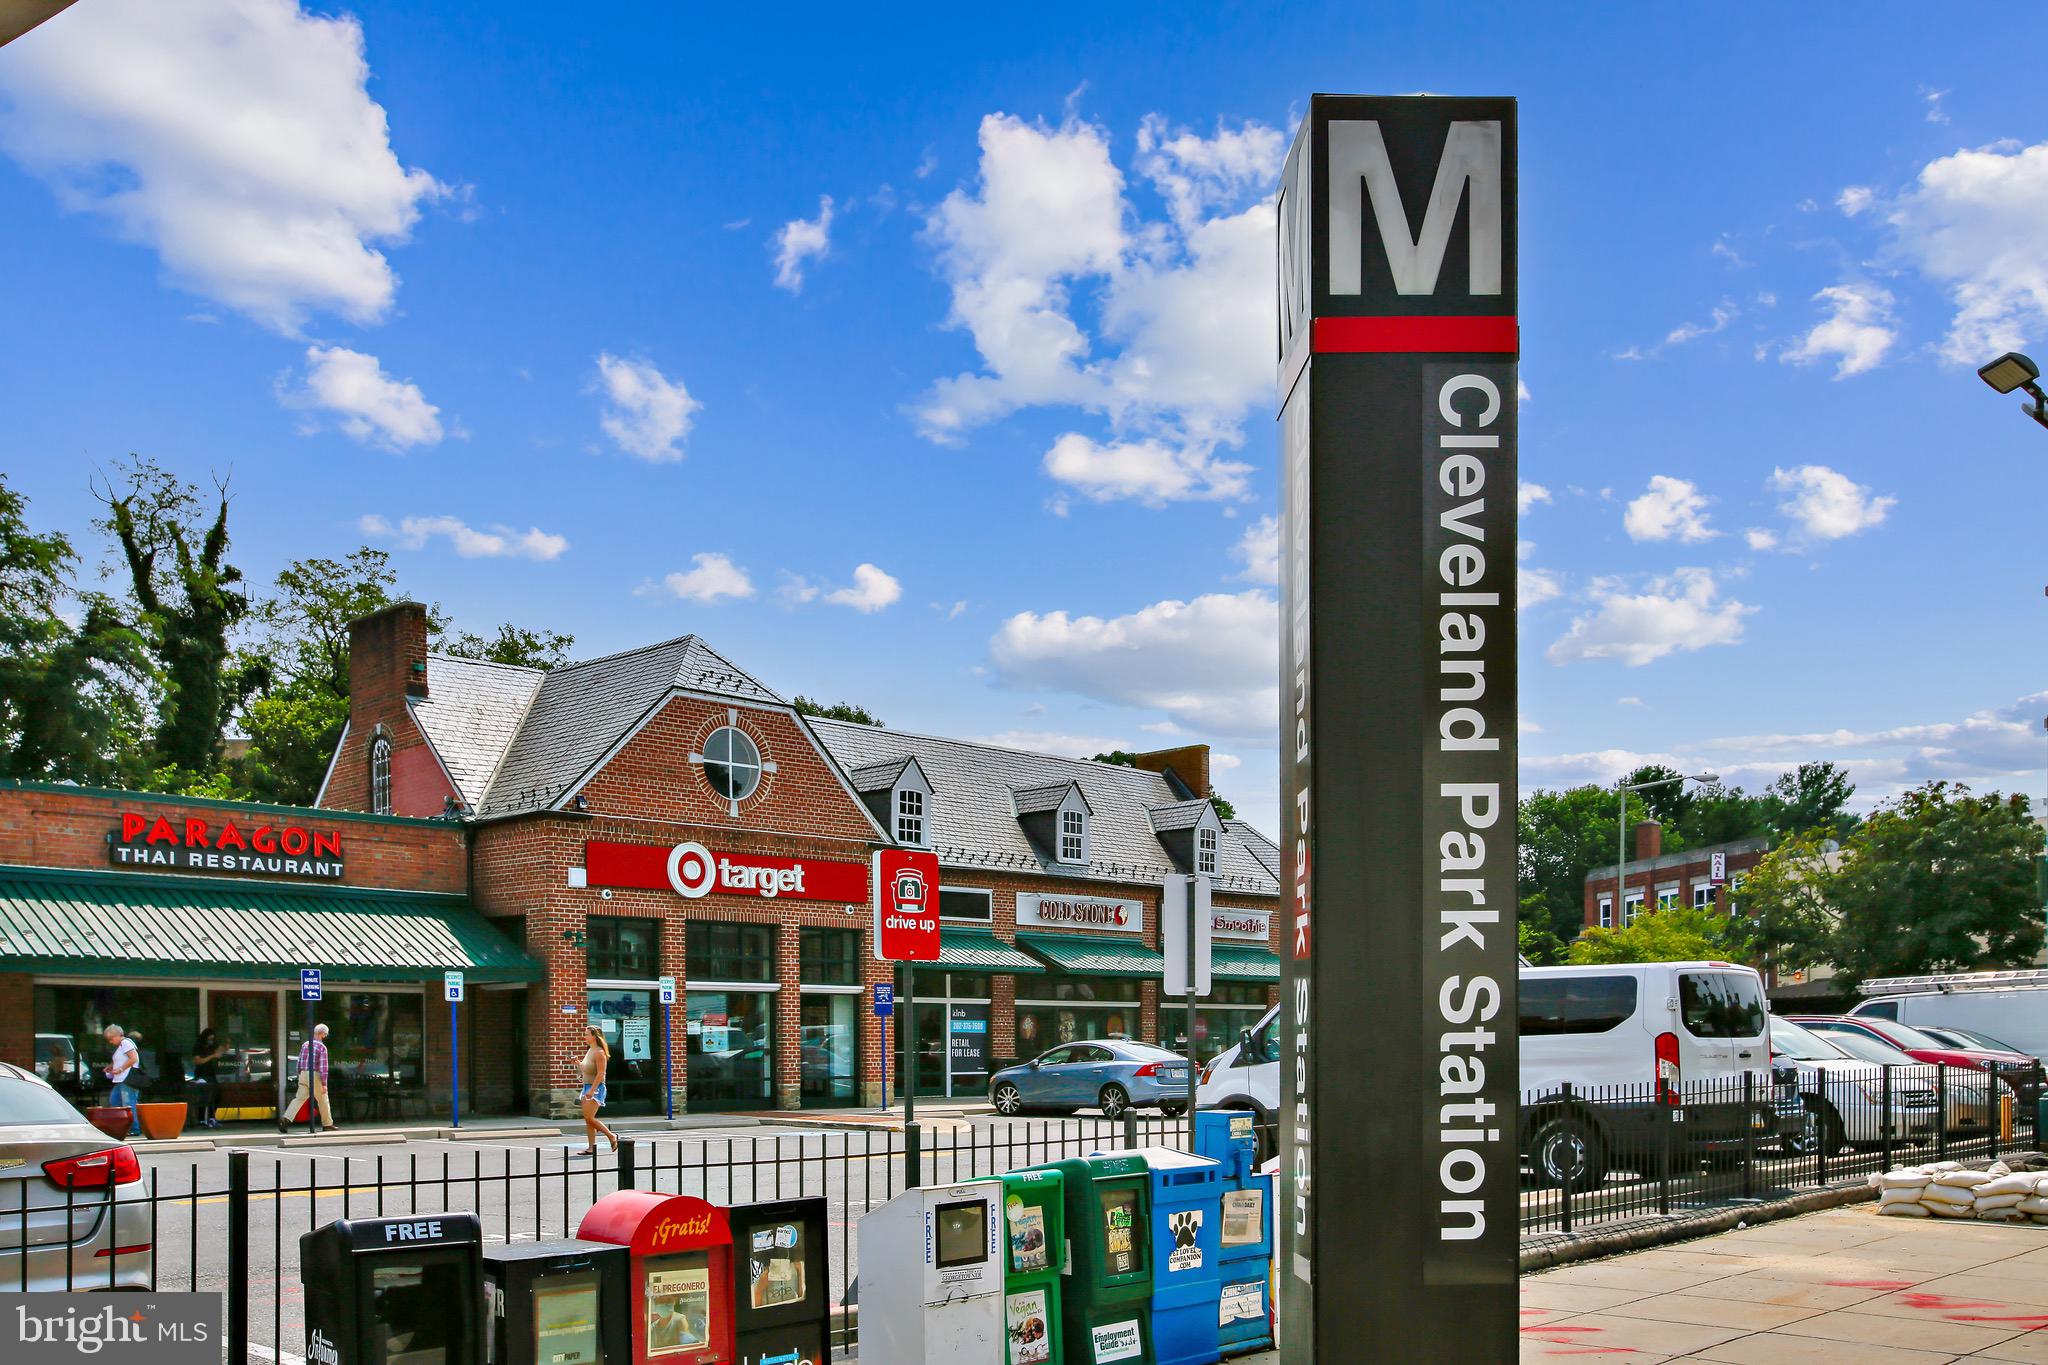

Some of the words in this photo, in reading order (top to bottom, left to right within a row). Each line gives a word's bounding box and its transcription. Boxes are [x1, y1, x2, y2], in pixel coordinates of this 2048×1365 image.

[1329, 119, 1502, 295] M
[1439, 373, 1501, 752] Cleveland
[1291, 394, 1310, 762] Cleveland
[121, 813, 341, 858] PARAGON
[117, 847, 175, 866] THAI
[188, 851, 344, 877] RESTAURANT
[1294, 785, 1310, 957] Park
[1439, 782, 1501, 951] Park
[1713, 854, 1723, 878] NAIL
[718, 858, 806, 898] target
[1040, 899, 1073, 920] COLD
[885, 914, 918, 930] drive
[919, 917, 936, 932] up
[1214, 915, 1266, 933] Smoothie
[951, 1038, 971, 1048] RETAIL
[951, 1048, 963, 1058] FOR
[963, 1048, 981, 1058] LEASE
[1293, 977, 1310, 1237] Station
[1439, 975, 1501, 1241] Station
[1023, 1172, 1044, 1182] FREE
[384, 1220, 443, 1242] FREE
[651, 1212, 712, 1247] ¡Gratis!
[1169, 1252, 1202, 1264] COMPANION
[1178, 1261, 1192, 1270] .COM
[653, 1285, 661, 1293] EL
[662, 1281, 706, 1293] PREGONERO
[1010, 1299, 1038, 1318] Vegan
[1094, 1327, 1135, 1344] Employment
[1100, 1340, 1119, 1351] Guide
